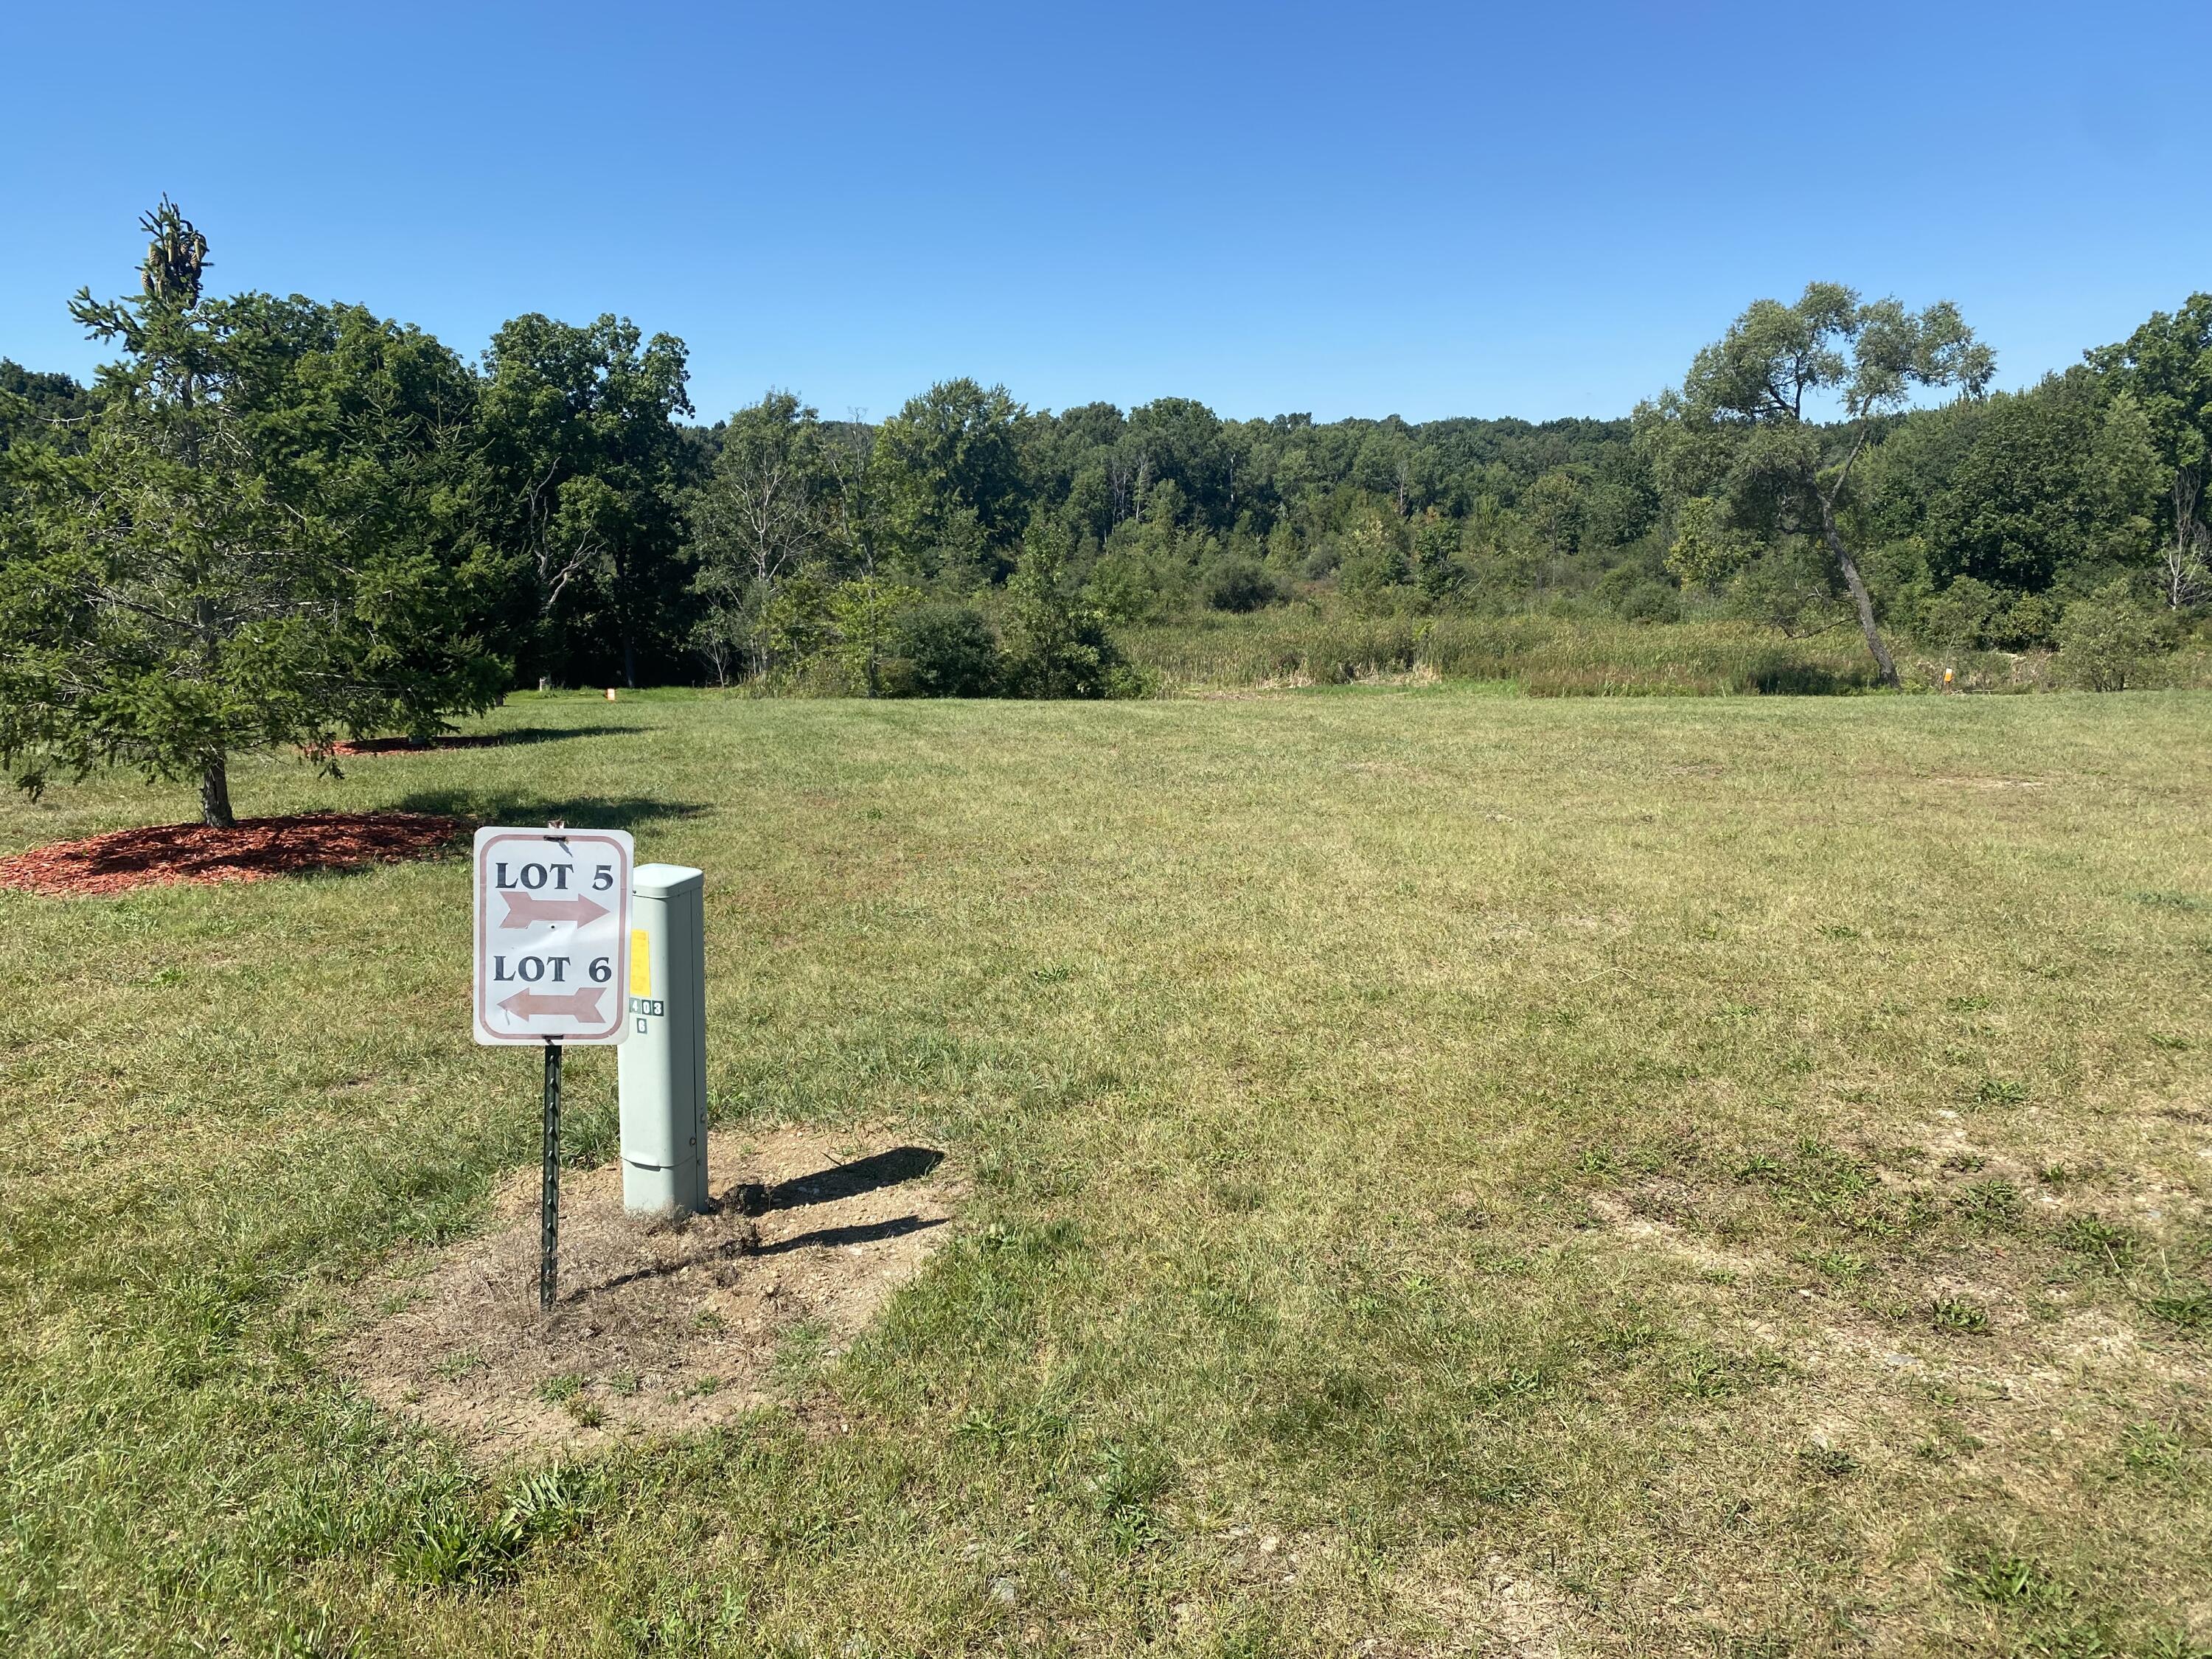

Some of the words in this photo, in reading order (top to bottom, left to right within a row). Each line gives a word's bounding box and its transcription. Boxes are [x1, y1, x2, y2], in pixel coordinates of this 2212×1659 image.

[495, 862, 574, 890] LOT
[592, 864, 613, 891] 5
[493, 956, 571, 982] LOT
[588, 956, 612, 983] 6
